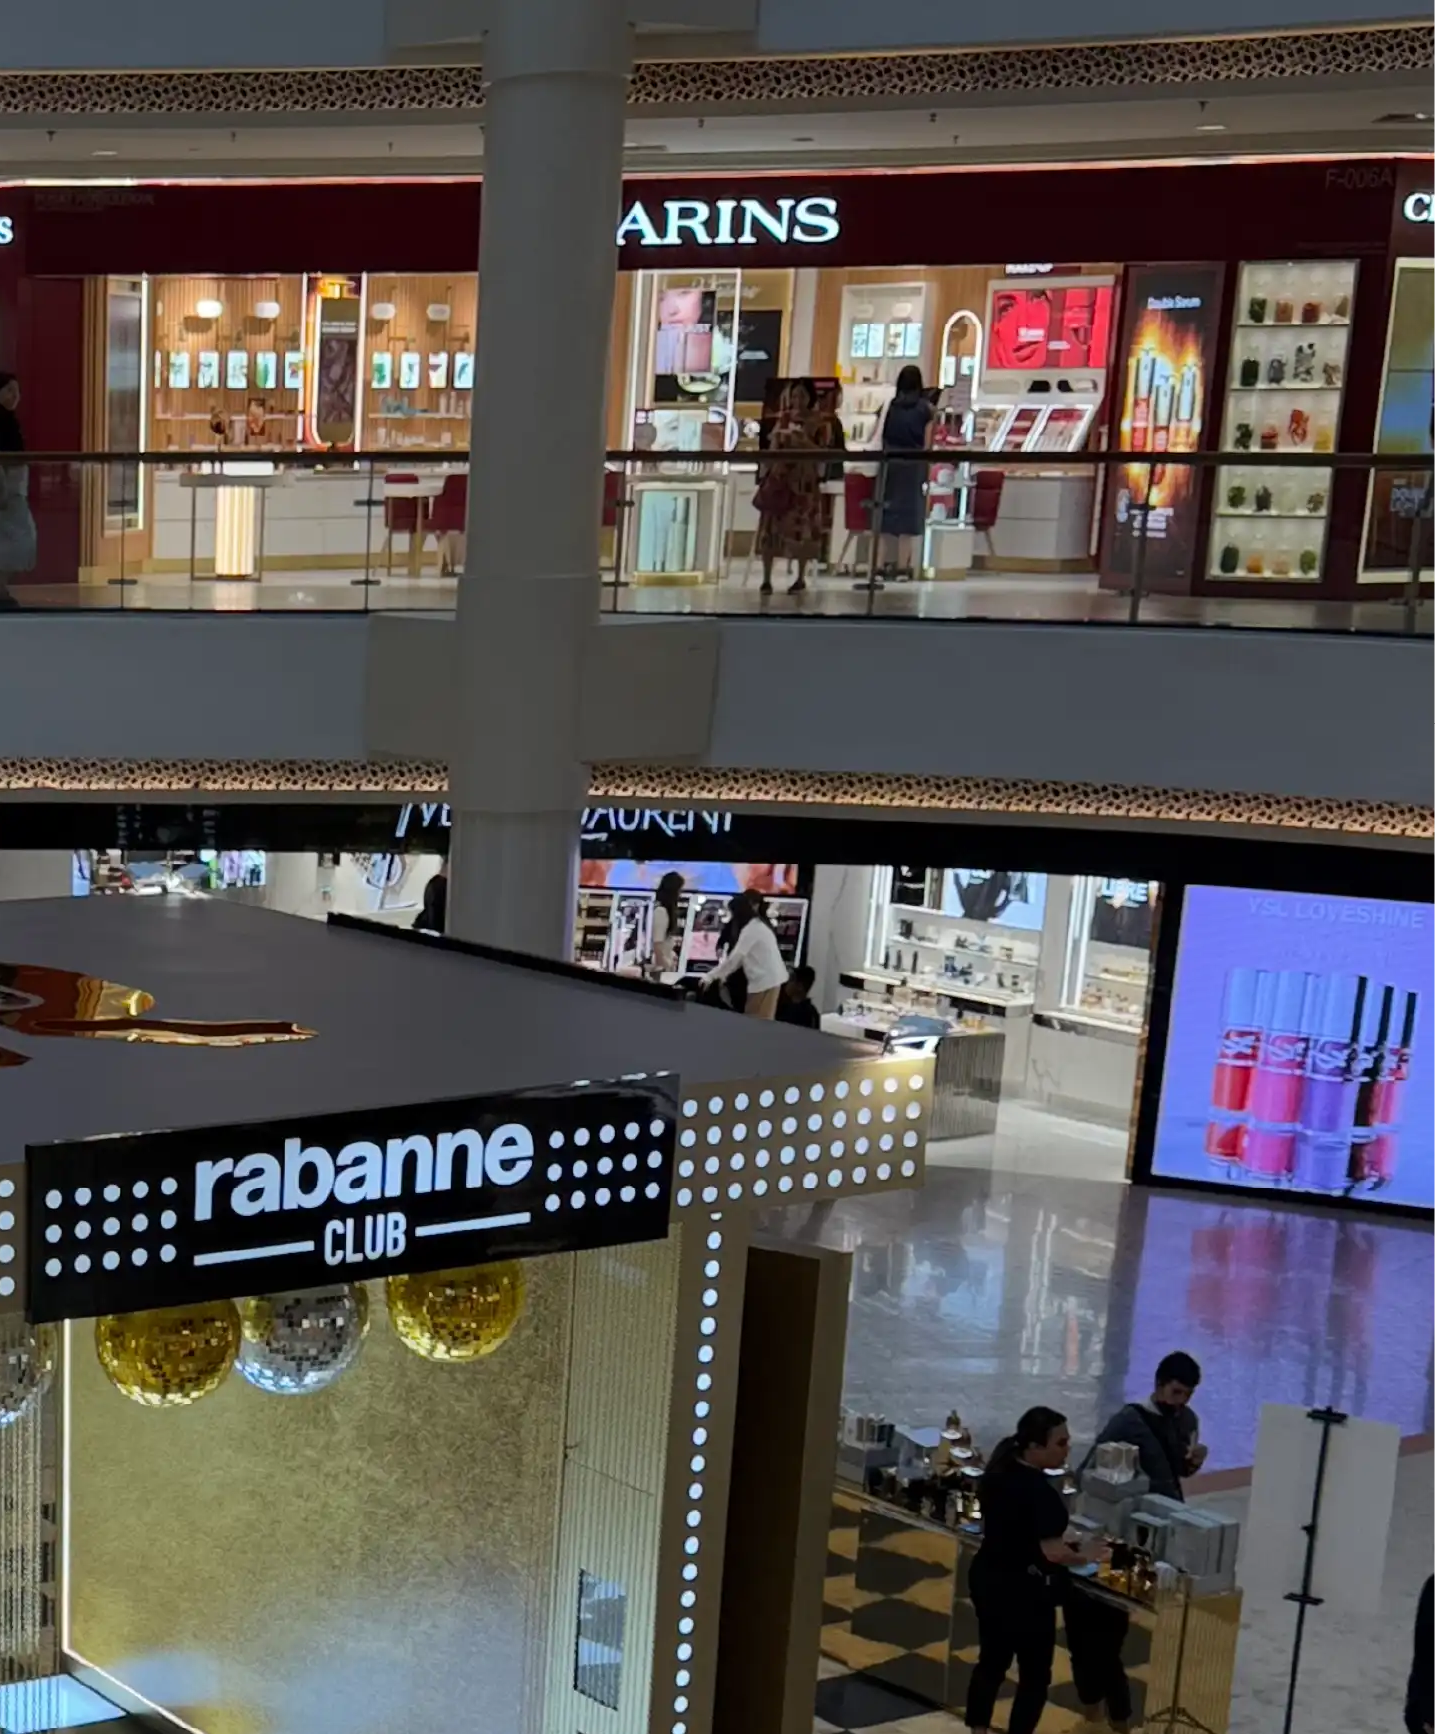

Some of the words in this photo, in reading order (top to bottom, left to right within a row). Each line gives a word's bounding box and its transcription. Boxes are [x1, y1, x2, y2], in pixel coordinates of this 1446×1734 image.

[616, 197, 841, 247] ARINS
[1248, 896, 1289, 918] YSL
[1294, 901, 1427, 930] LOVESHINE
[194, 1122, 535, 1221] rabanne
[323, 1212, 407, 1267] CLUB
